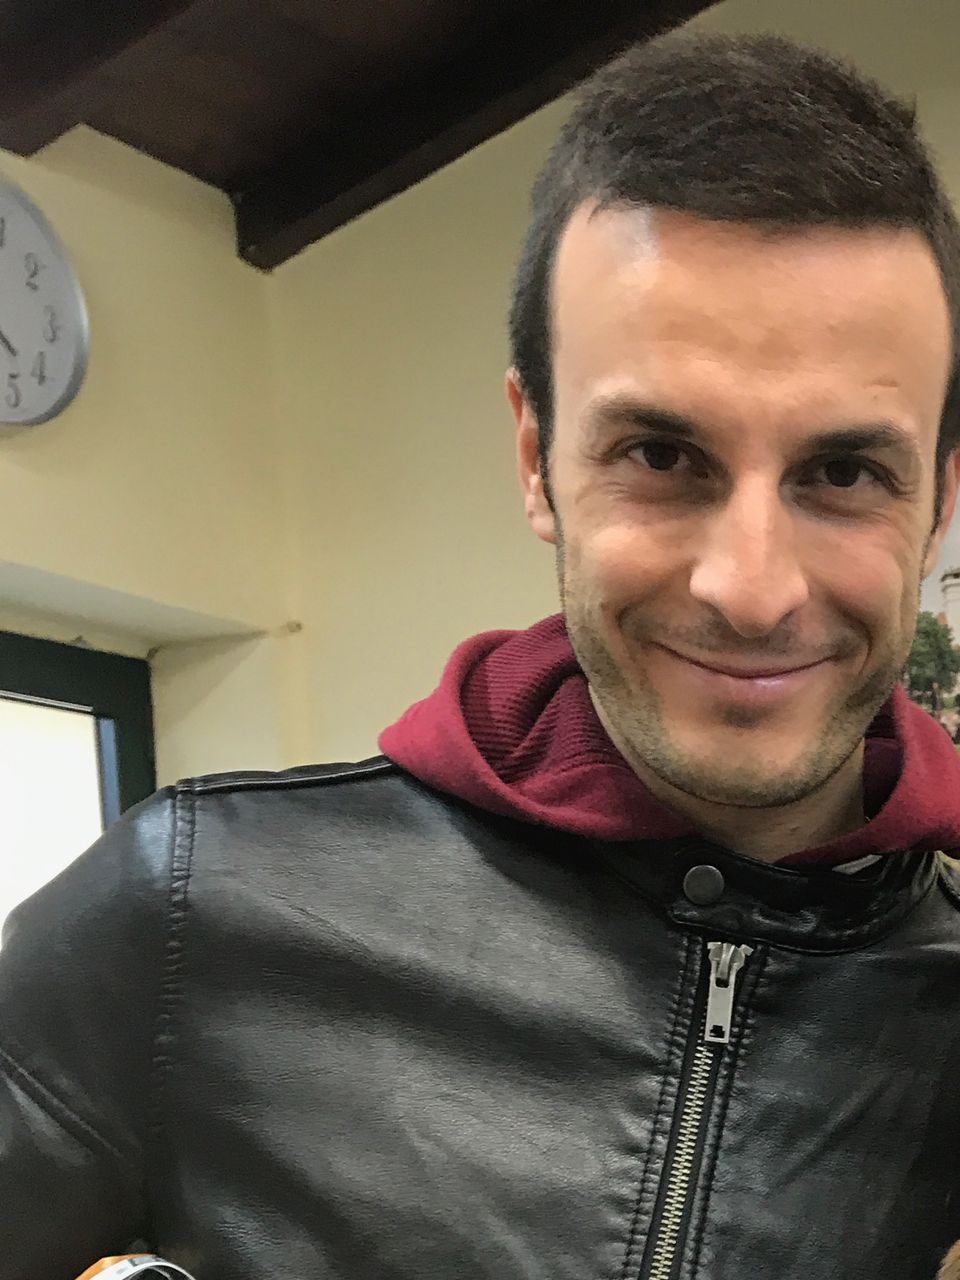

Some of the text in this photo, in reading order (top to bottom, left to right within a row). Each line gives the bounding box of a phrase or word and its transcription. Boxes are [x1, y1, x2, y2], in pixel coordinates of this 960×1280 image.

[24, 252, 42, 292] 2
[42, 304, 60, 345] 3
[30, 350, 48, 386] 4
[5, 372, 22, 408] 5
